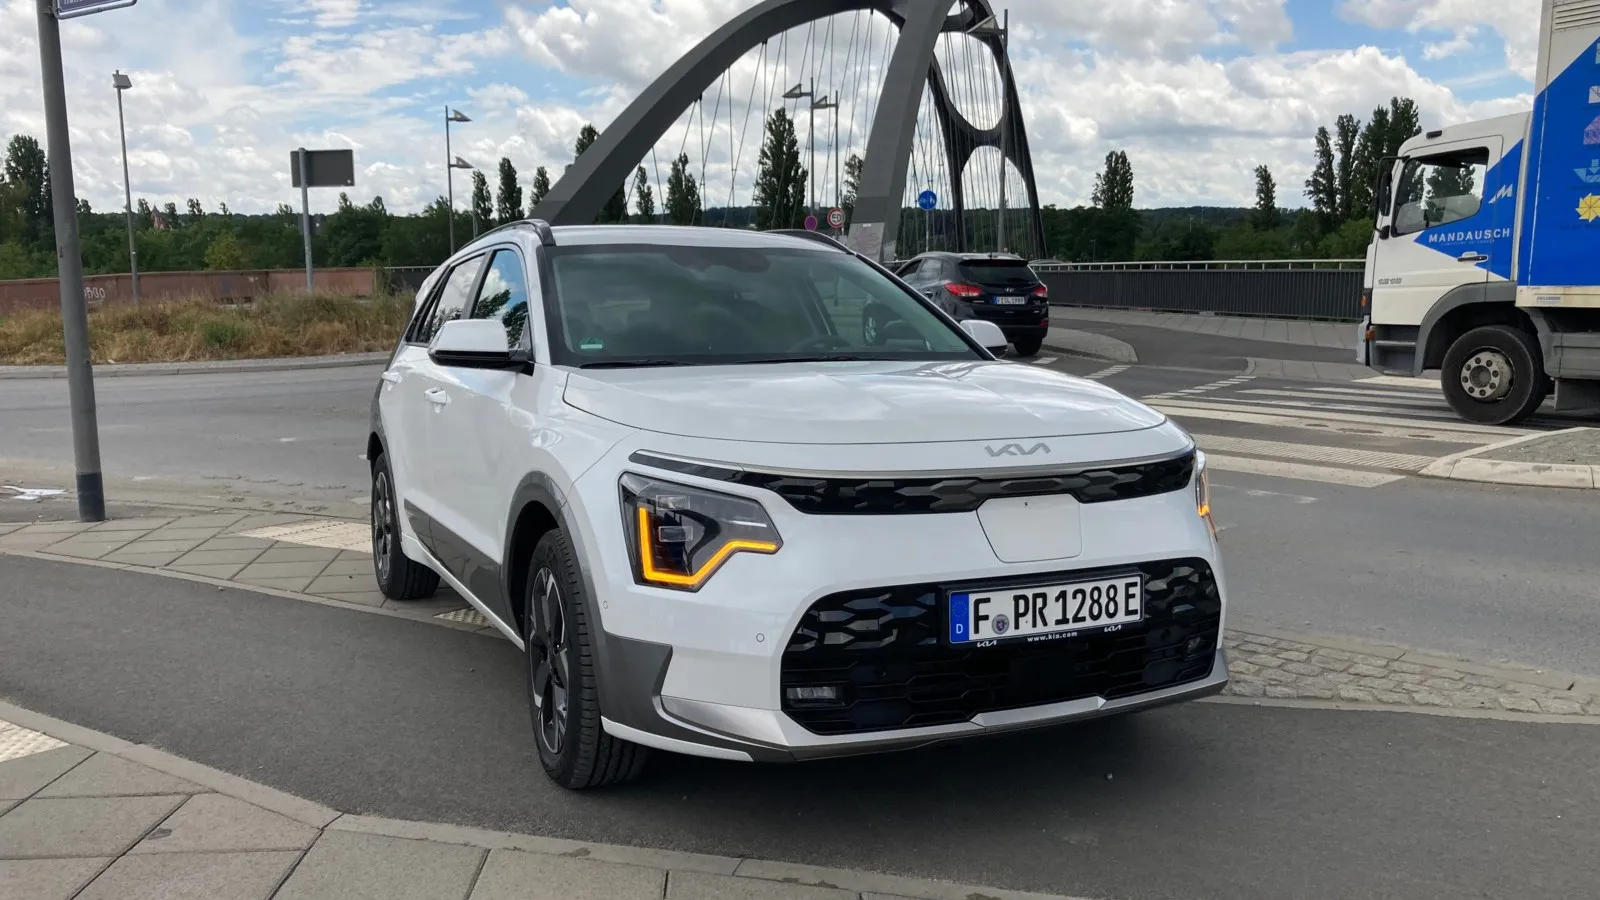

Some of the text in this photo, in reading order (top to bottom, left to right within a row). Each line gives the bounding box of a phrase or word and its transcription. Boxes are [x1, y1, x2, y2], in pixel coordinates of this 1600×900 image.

[832, 213, 842, 223] 50
[1428, 227, 1510, 243] MANDAUSCH
[973, 597, 991, 634] F
[1013, 592, 1048, 630] PR
[956, 623, 964, 634] D
[1027, 631, 1078, 642] www.kia.com
